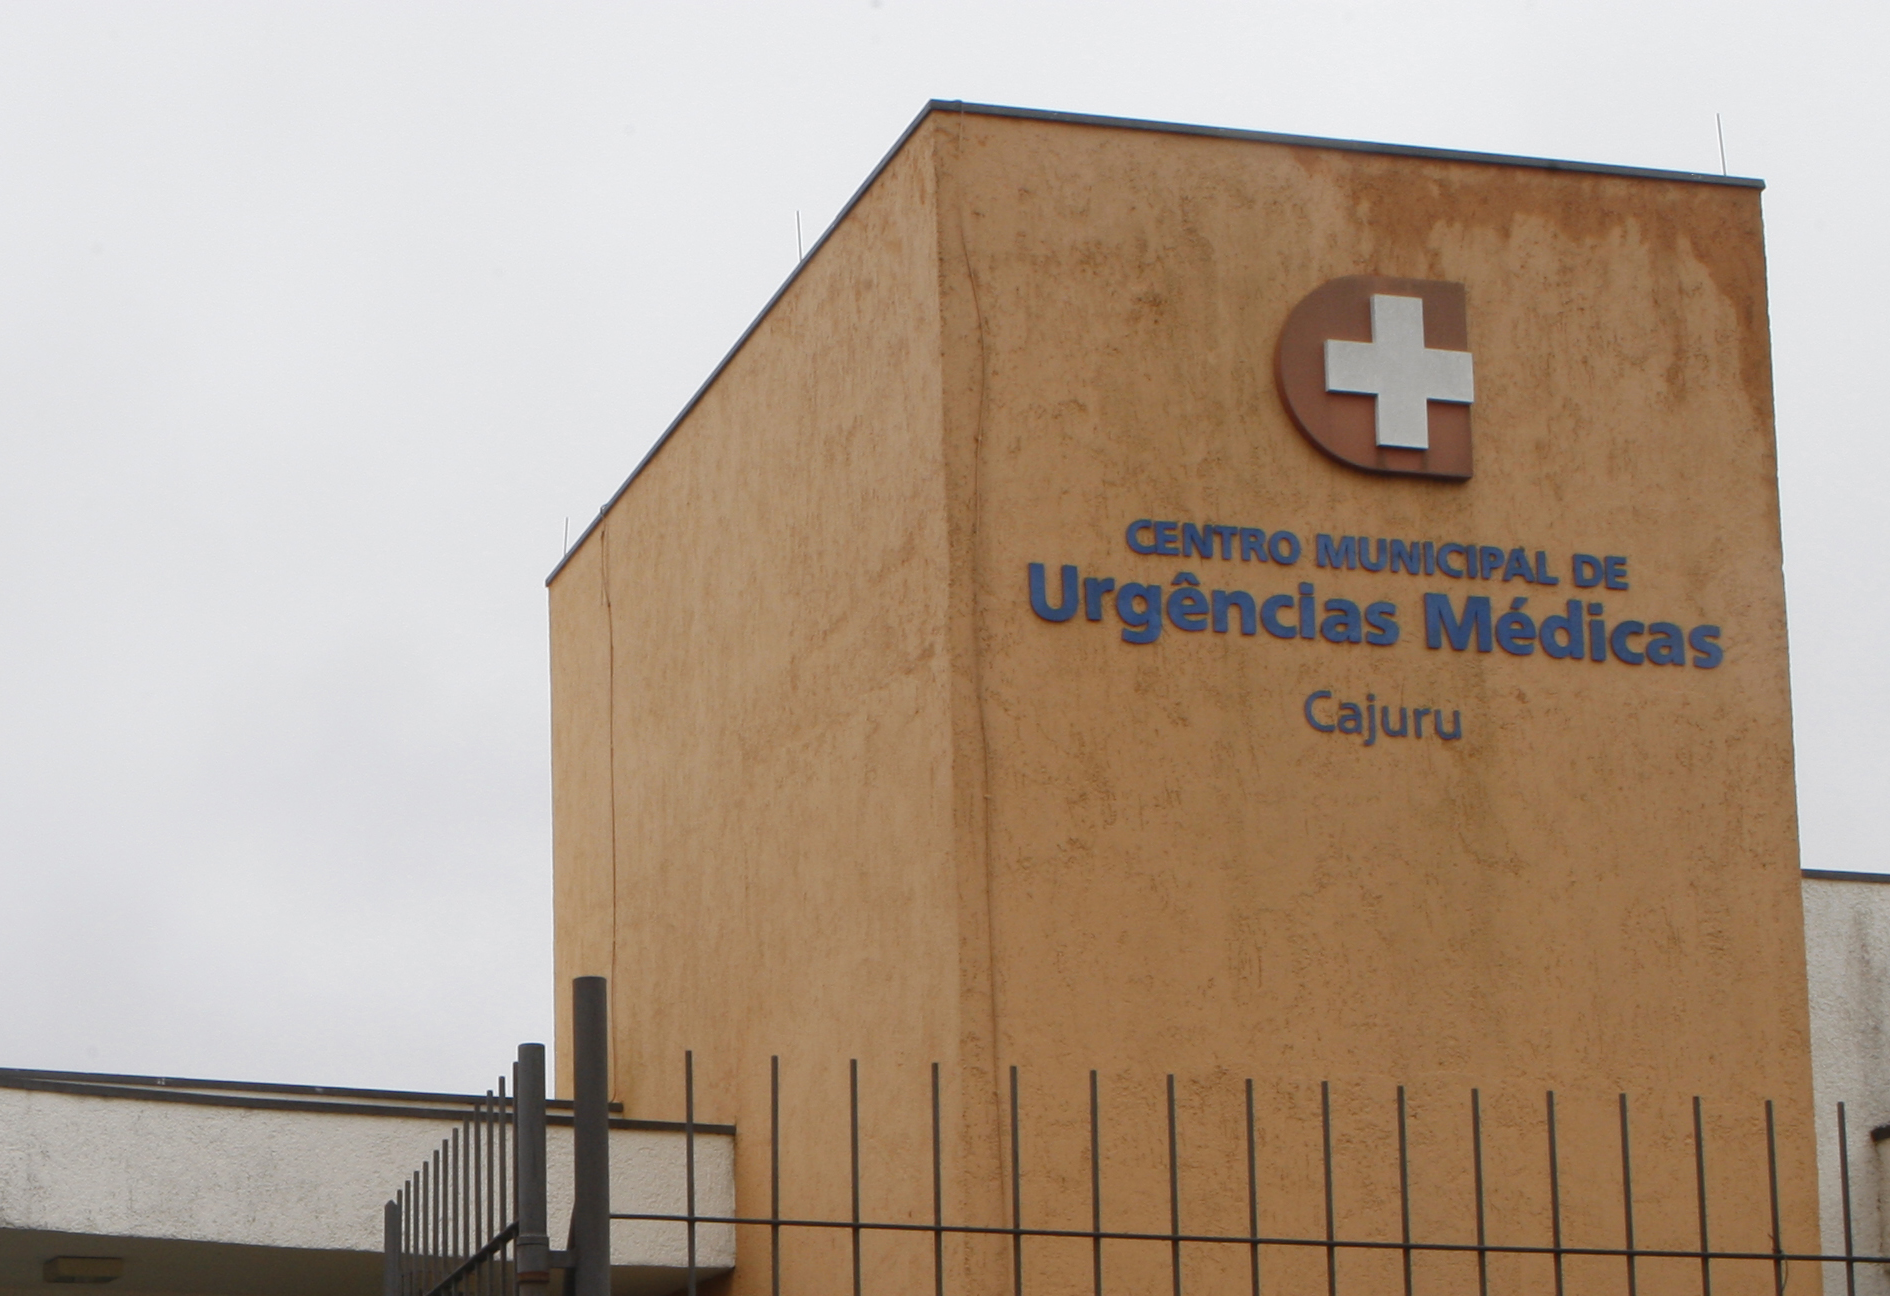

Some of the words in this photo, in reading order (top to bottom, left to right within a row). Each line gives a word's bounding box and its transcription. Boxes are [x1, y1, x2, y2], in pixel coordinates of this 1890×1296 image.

[1126, 519, 1301, 566] CENTRO
[1316, 533, 1559, 585] MUNICIPAL
[1573, 553, 1630, 590] DE
[1028, 562, 1400, 646] Urgências
[1423, 592, 1724, 669] Médicas
[1304, 690, 1462, 746] Cajuru
